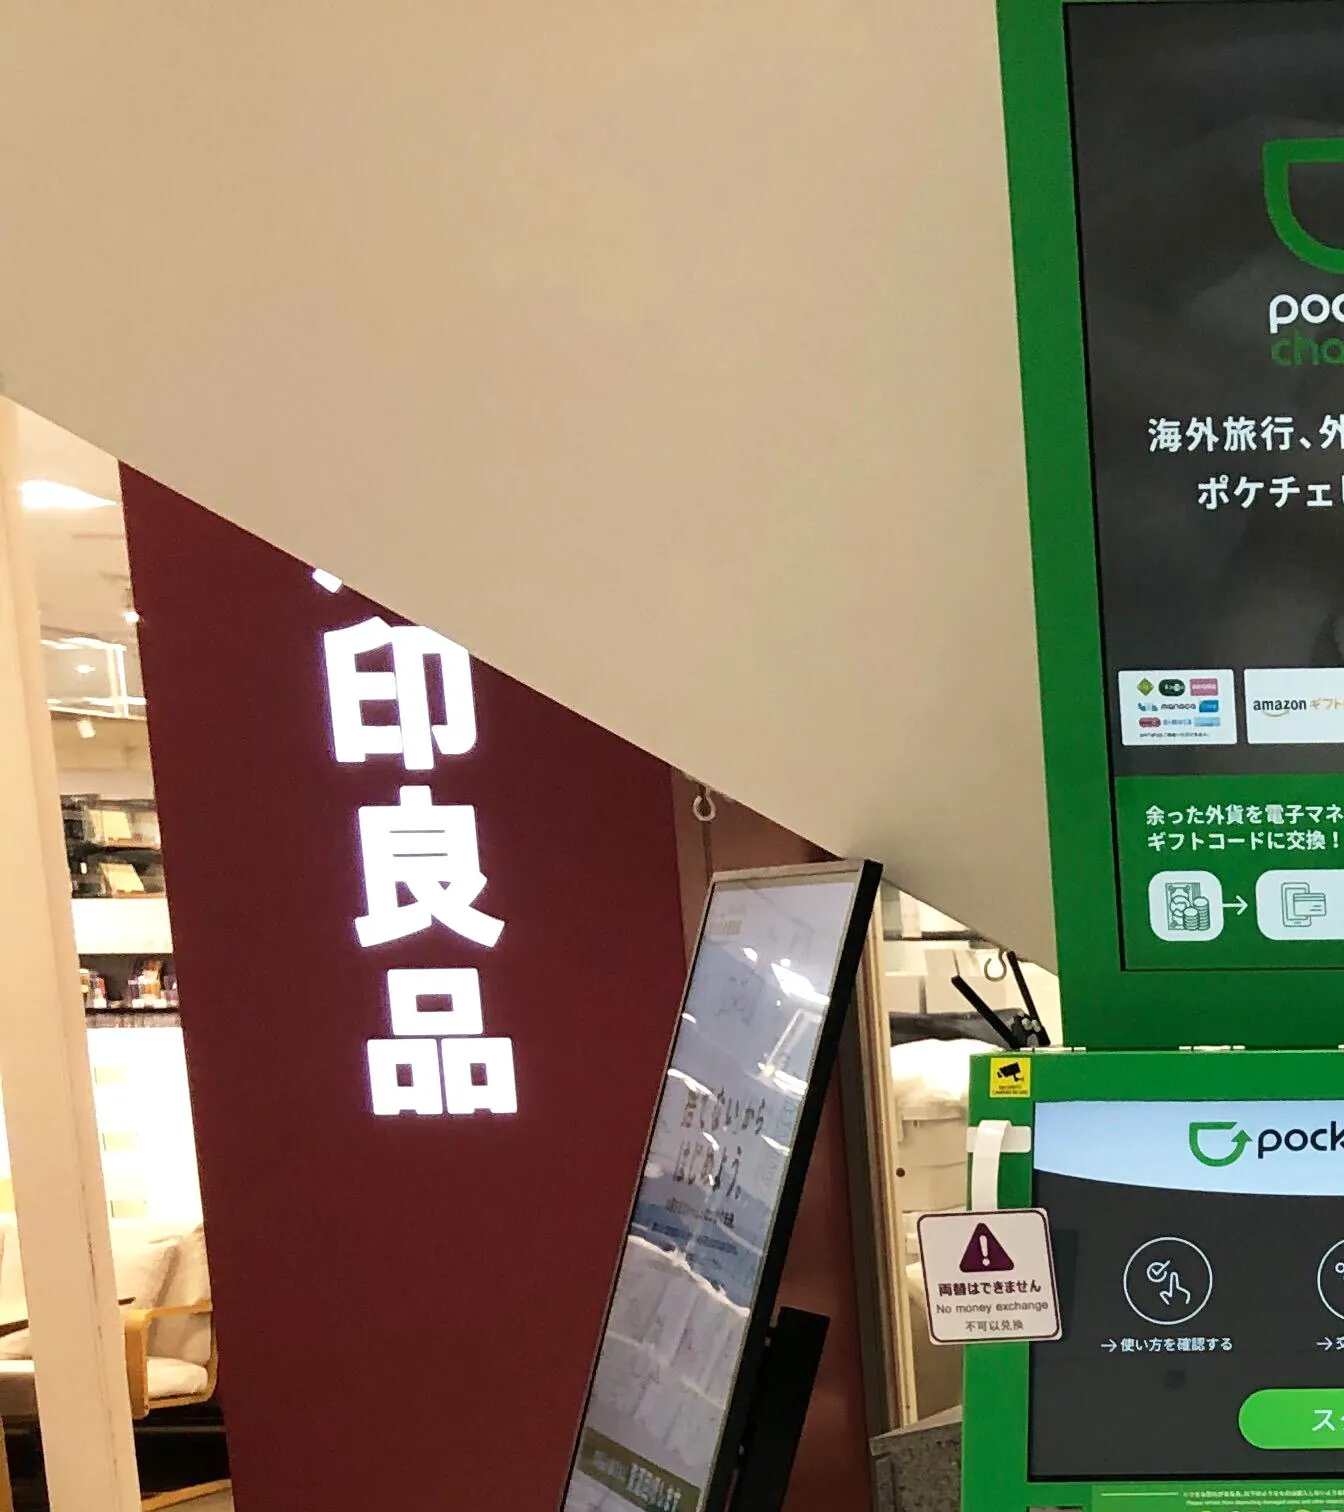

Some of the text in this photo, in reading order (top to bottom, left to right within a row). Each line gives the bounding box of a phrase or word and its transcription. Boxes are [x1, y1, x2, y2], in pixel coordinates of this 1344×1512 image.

[1253, 699, 1307, 712] amazon
[312, 568, 518, 1116] 印良品
[1147, 830, 1340, 851] ギフトコードに交換！
[938, 1279, 1042, 1297] 両替はできません
[936, 1300, 1048, 1315] No money exchange
[1120, 1337, 1233, 1351] 使い方を確認する
